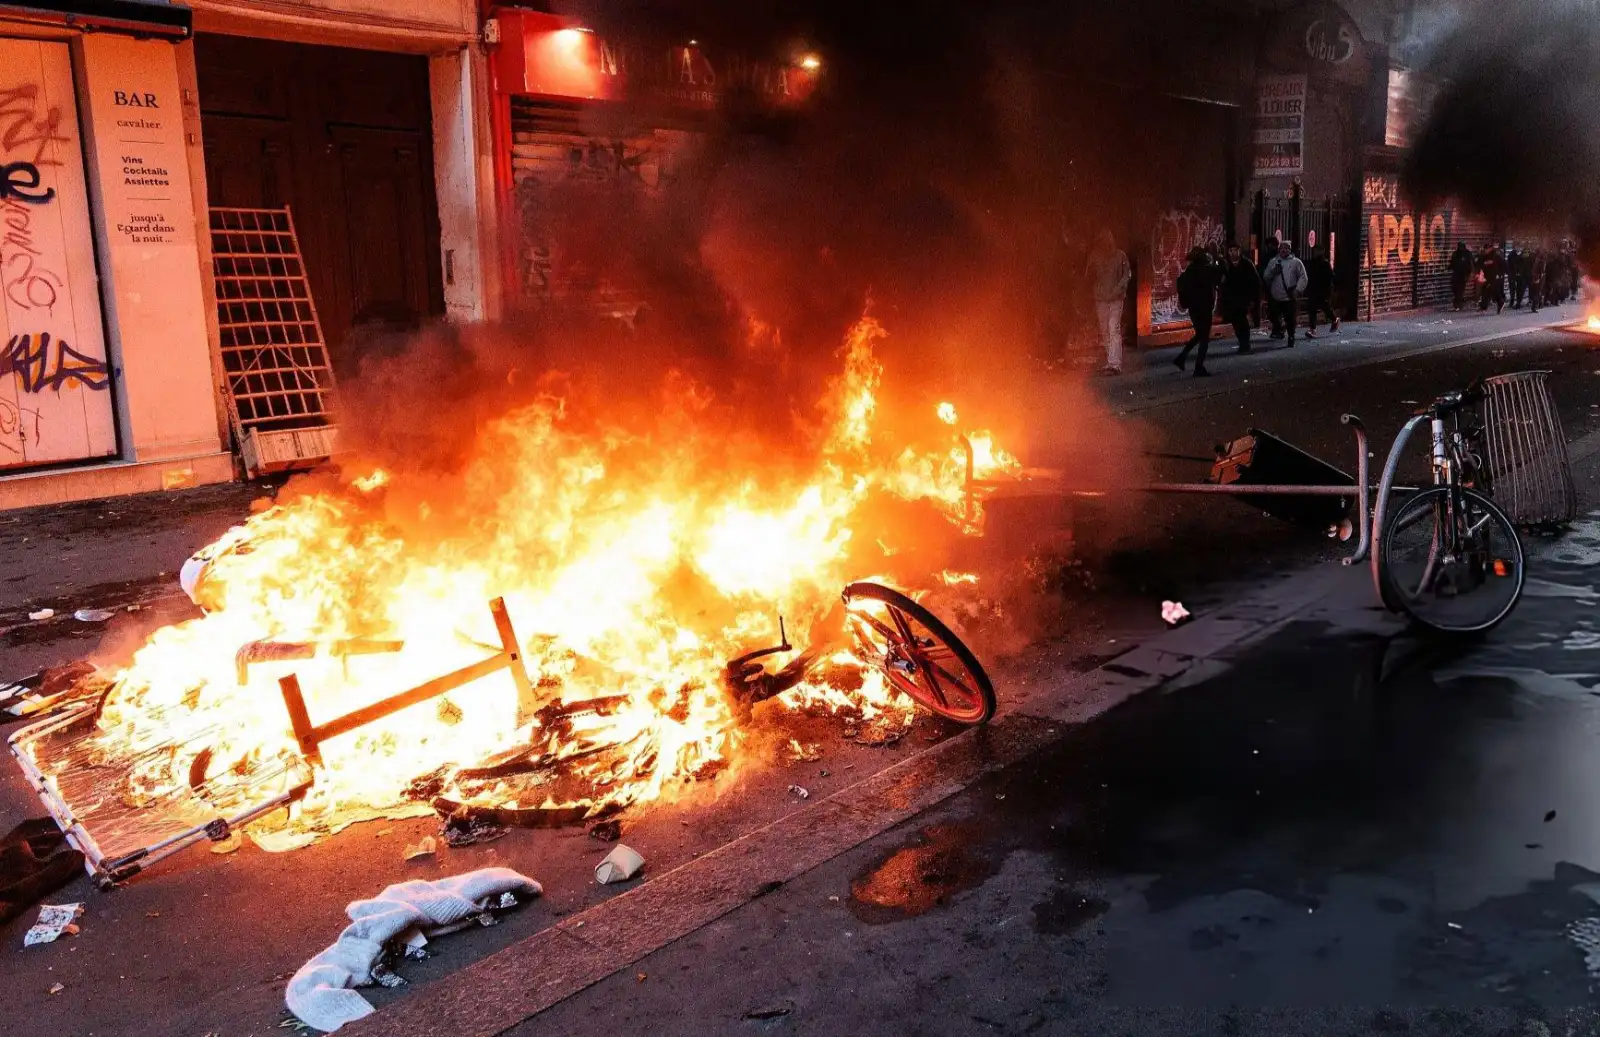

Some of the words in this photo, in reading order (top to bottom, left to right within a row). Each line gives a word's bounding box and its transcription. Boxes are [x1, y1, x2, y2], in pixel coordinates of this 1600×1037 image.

[114, 90, 160, 109] BAR
[122, 156, 143, 164] Vins
[123, 167, 168, 176] Cocktails
[124, 178, 170, 186] Assiettes
[152, 224, 175, 233] dans
[132, 235, 141, 243] la
